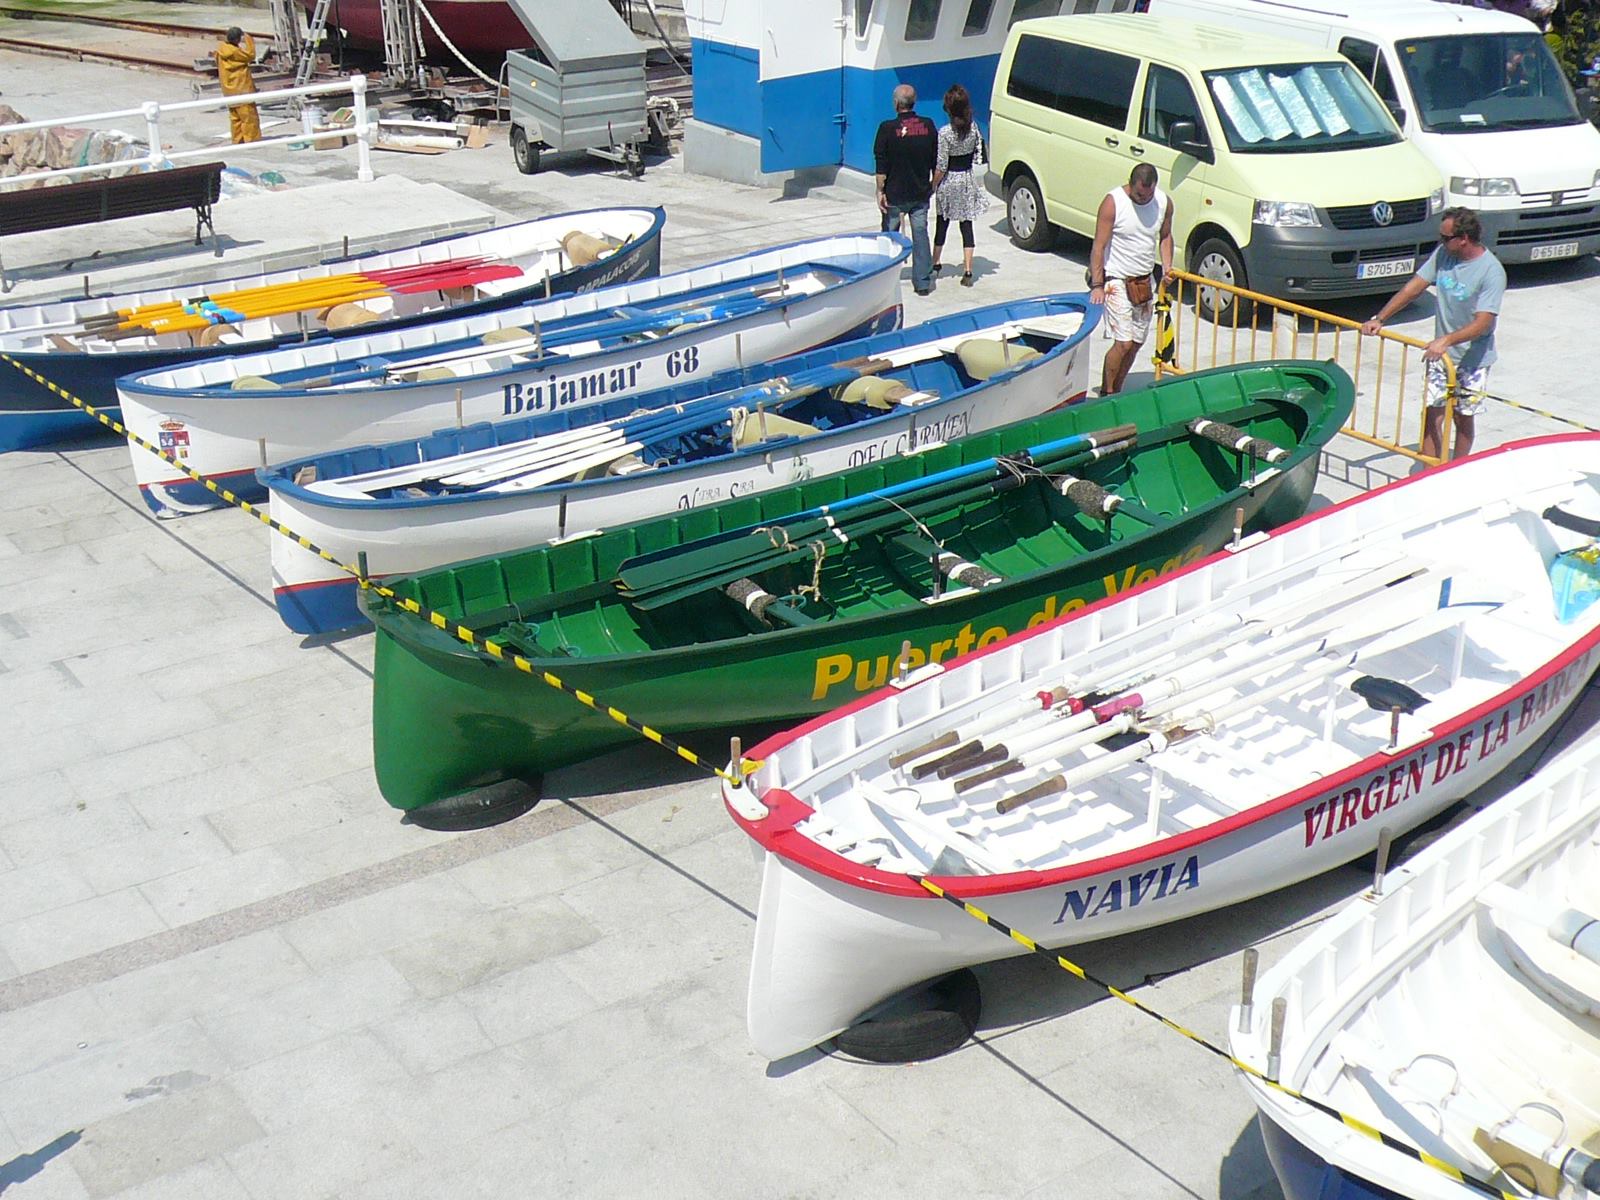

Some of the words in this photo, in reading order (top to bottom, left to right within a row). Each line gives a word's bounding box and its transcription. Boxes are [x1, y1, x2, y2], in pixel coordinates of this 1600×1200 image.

[502, 361, 642, 416] Bajamar
[666, 346, 699, 378] 68
[1304, 753, 1428, 848] VIRGEN
[1432, 731, 1474, 786] DE
[1478, 710, 1510, 762] LA
[1053, 855, 1200, 925] NAVIA
